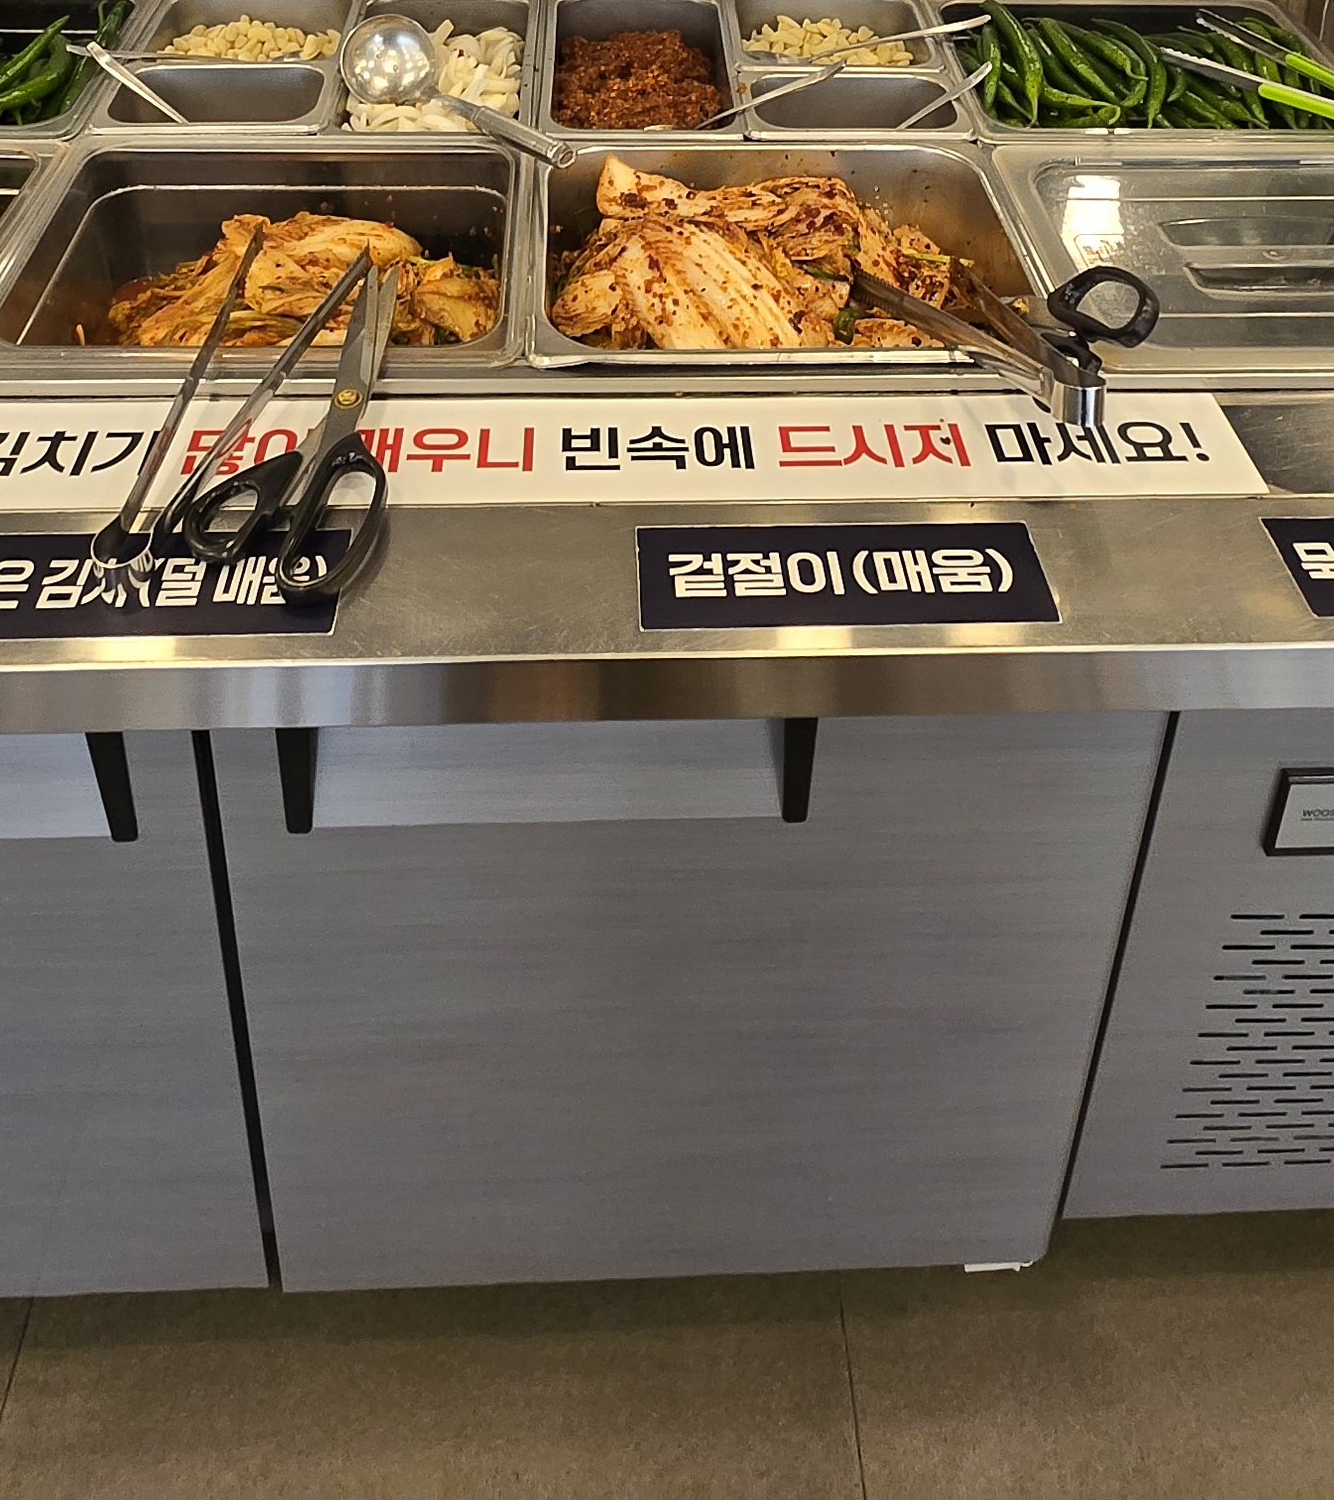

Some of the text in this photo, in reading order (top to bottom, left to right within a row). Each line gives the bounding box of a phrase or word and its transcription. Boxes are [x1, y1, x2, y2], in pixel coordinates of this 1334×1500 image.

[561, 425, 756, 471] 빈속에
[778, 422, 972, 469] 드시지
[984, 421, 1210, 466] 마세요!
